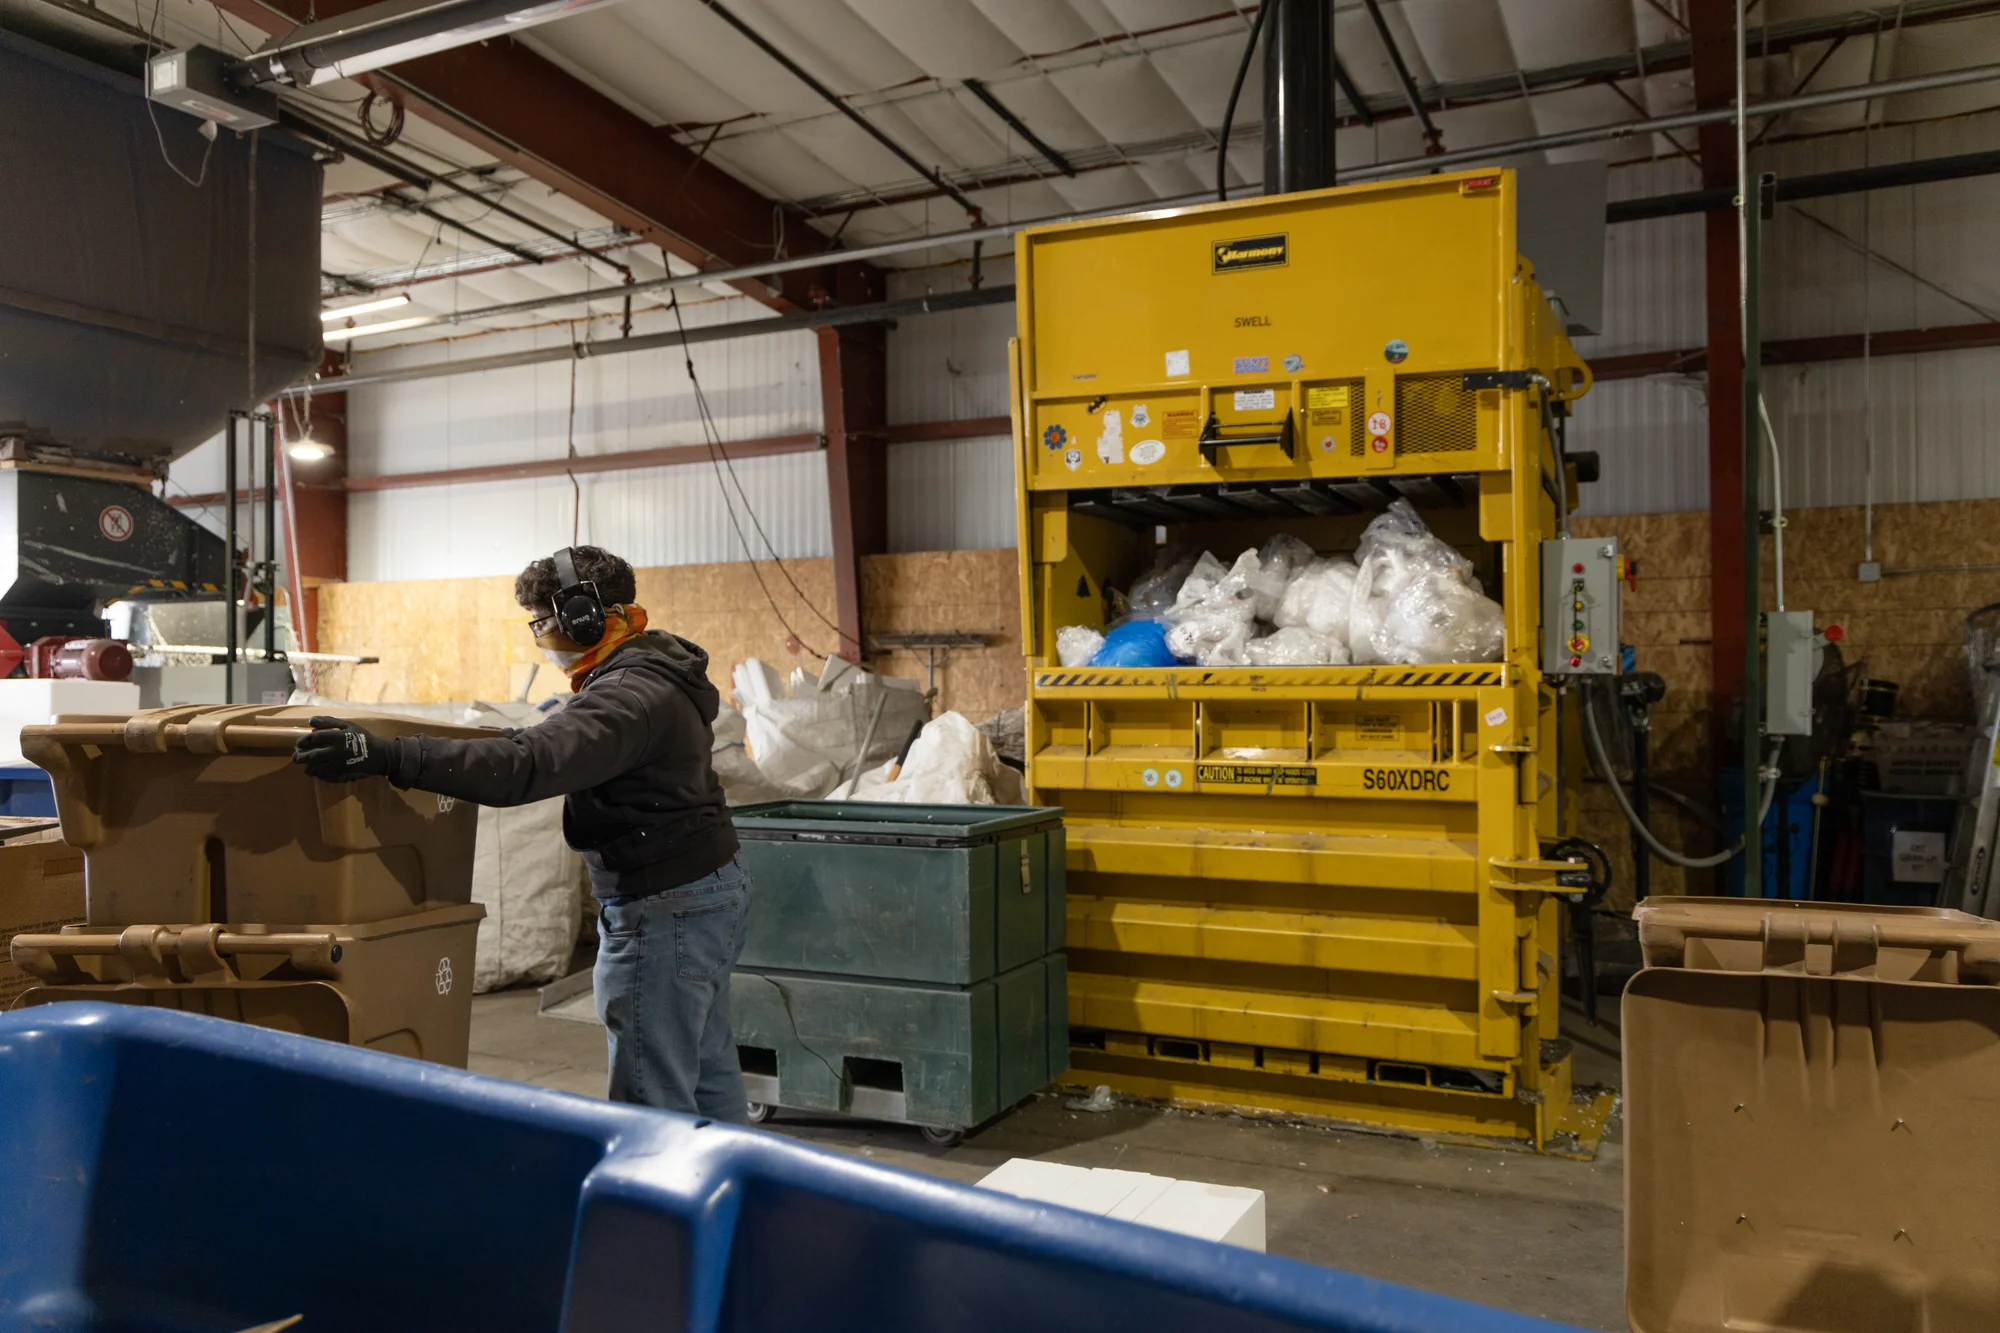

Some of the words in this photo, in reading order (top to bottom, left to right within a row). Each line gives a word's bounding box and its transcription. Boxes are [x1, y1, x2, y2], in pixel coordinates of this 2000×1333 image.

[1228, 246, 1284, 260] Harmony
[1234, 316, 1272, 328] SWELL
[1197, 766, 1235, 781] CAUTION
[1363, 768, 1450, 792] S60XDRC
